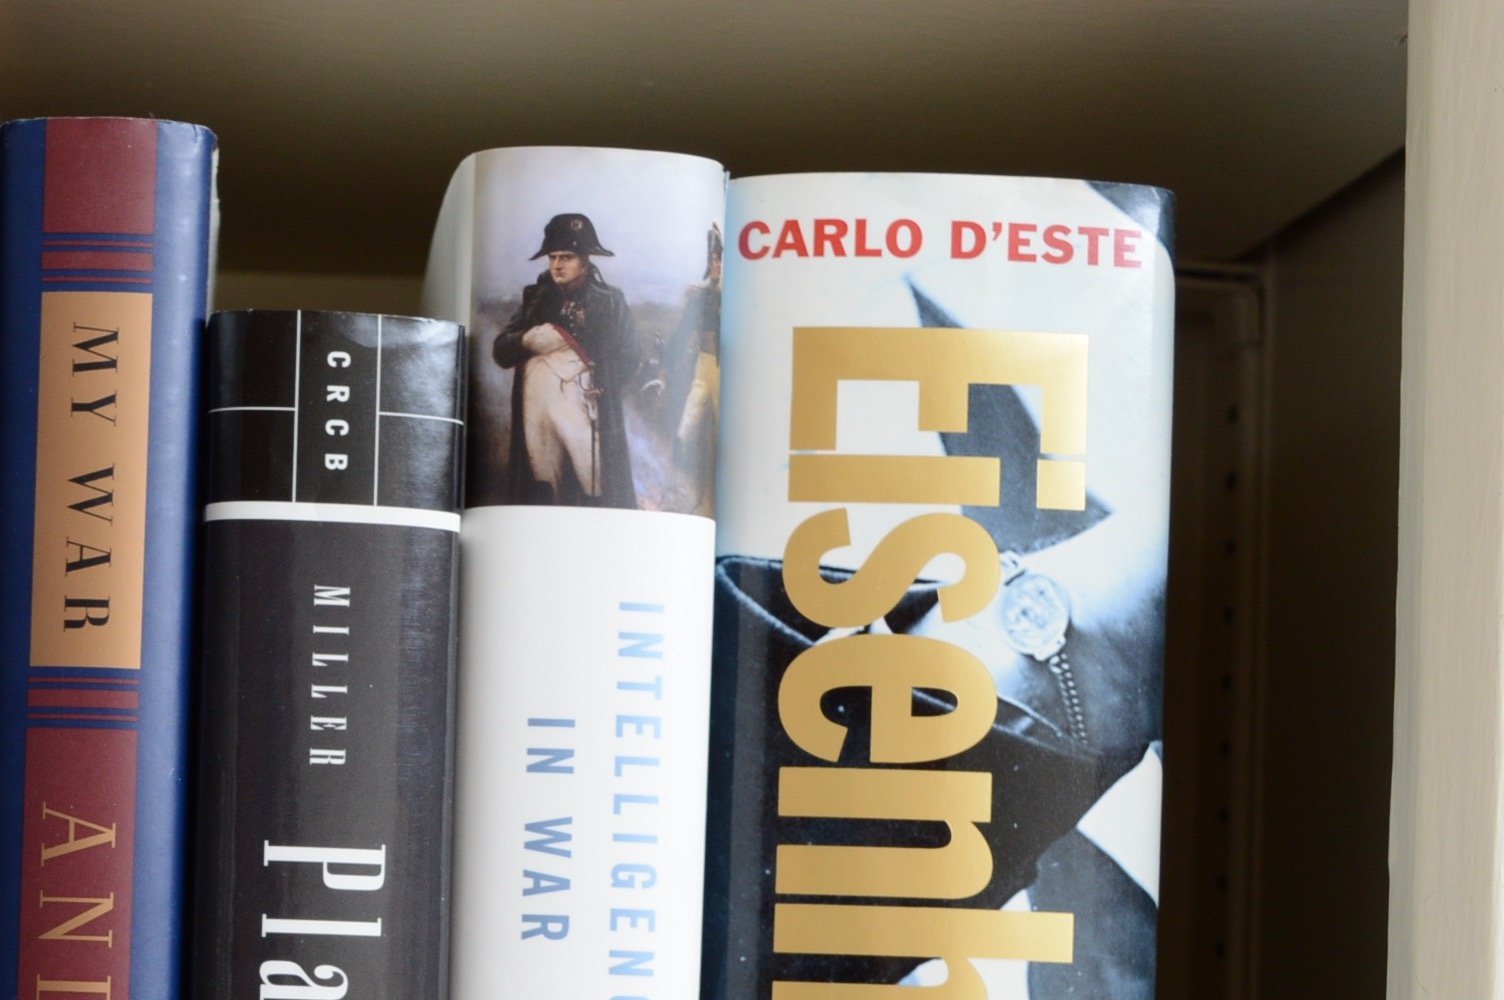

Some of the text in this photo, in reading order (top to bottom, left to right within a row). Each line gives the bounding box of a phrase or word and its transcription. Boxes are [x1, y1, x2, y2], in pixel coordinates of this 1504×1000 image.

[738, 218, 1142, 269] CARLO D'ESTE
[63, 321, 119, 632] MY WAR
[325, 350, 352, 471] CRCB
[309, 585, 350, 765] MILLER
[521, 718, 576, 941] IN WAR
